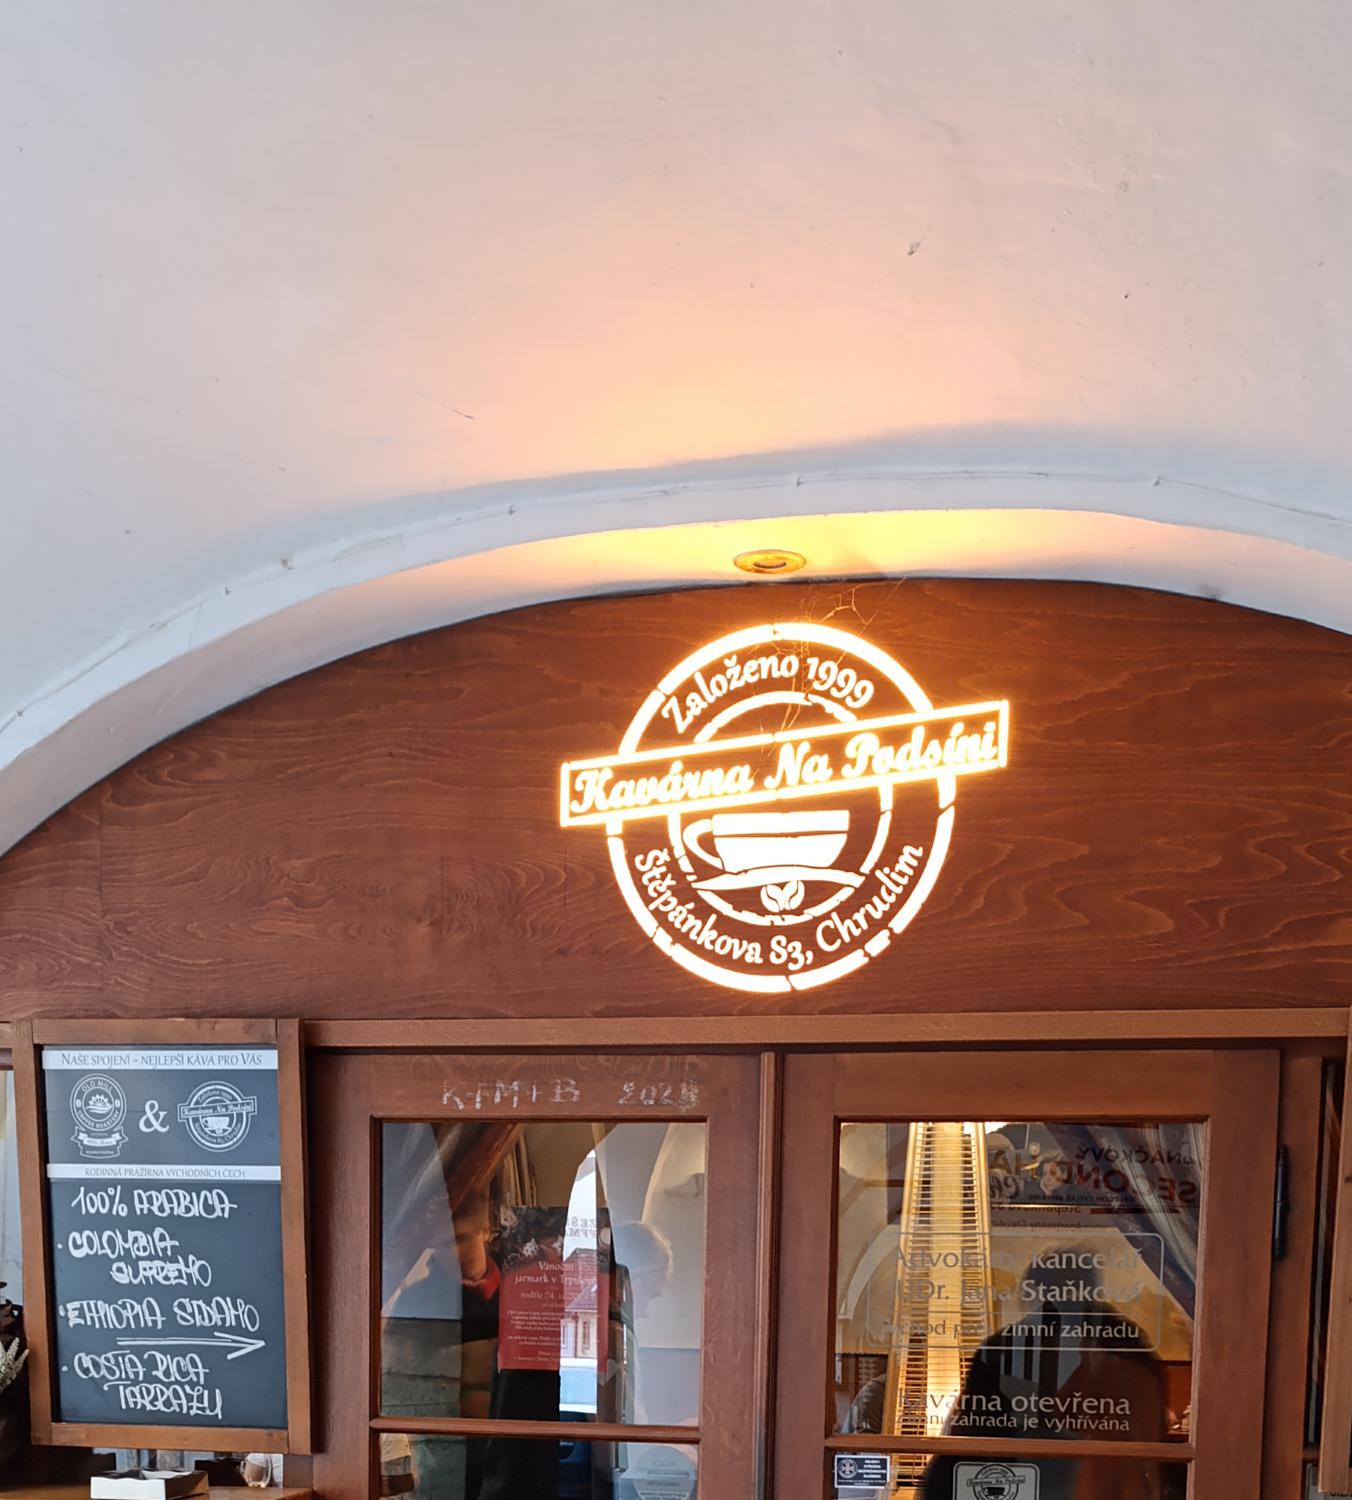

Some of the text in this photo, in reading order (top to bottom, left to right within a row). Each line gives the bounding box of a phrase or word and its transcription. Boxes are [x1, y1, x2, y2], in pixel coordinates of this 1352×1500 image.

[662, 655, 875, 734] Založeno 1999
[570, 721, 998, 814] Kavárna Na Podsíni
[635, 848, 763, 965] Štěpánkova
[816, 843, 925, 952] Chrudim
[71, 1185, 238, 1218] 100% ARABICA
[68, 1227, 179, 1259] COLOMBIA
[110, 1255, 212, 1287] SUPREMO
[68, 1296, 261, 1332] ETHIOPIA SIDAMO
[1001, 1321, 1055, 1337] zimní
[1061, 1321, 1139, 1338] zahradu
[74, 1351, 209, 1384] COSTA RICA
[1011, 1392, 1131, 1414] otevřena
[950, 1412, 1017, 1427] zahrada
[1023, 1413, 1039, 1431] je
[1044, 1414, 1130, 1432] vyhřívána
